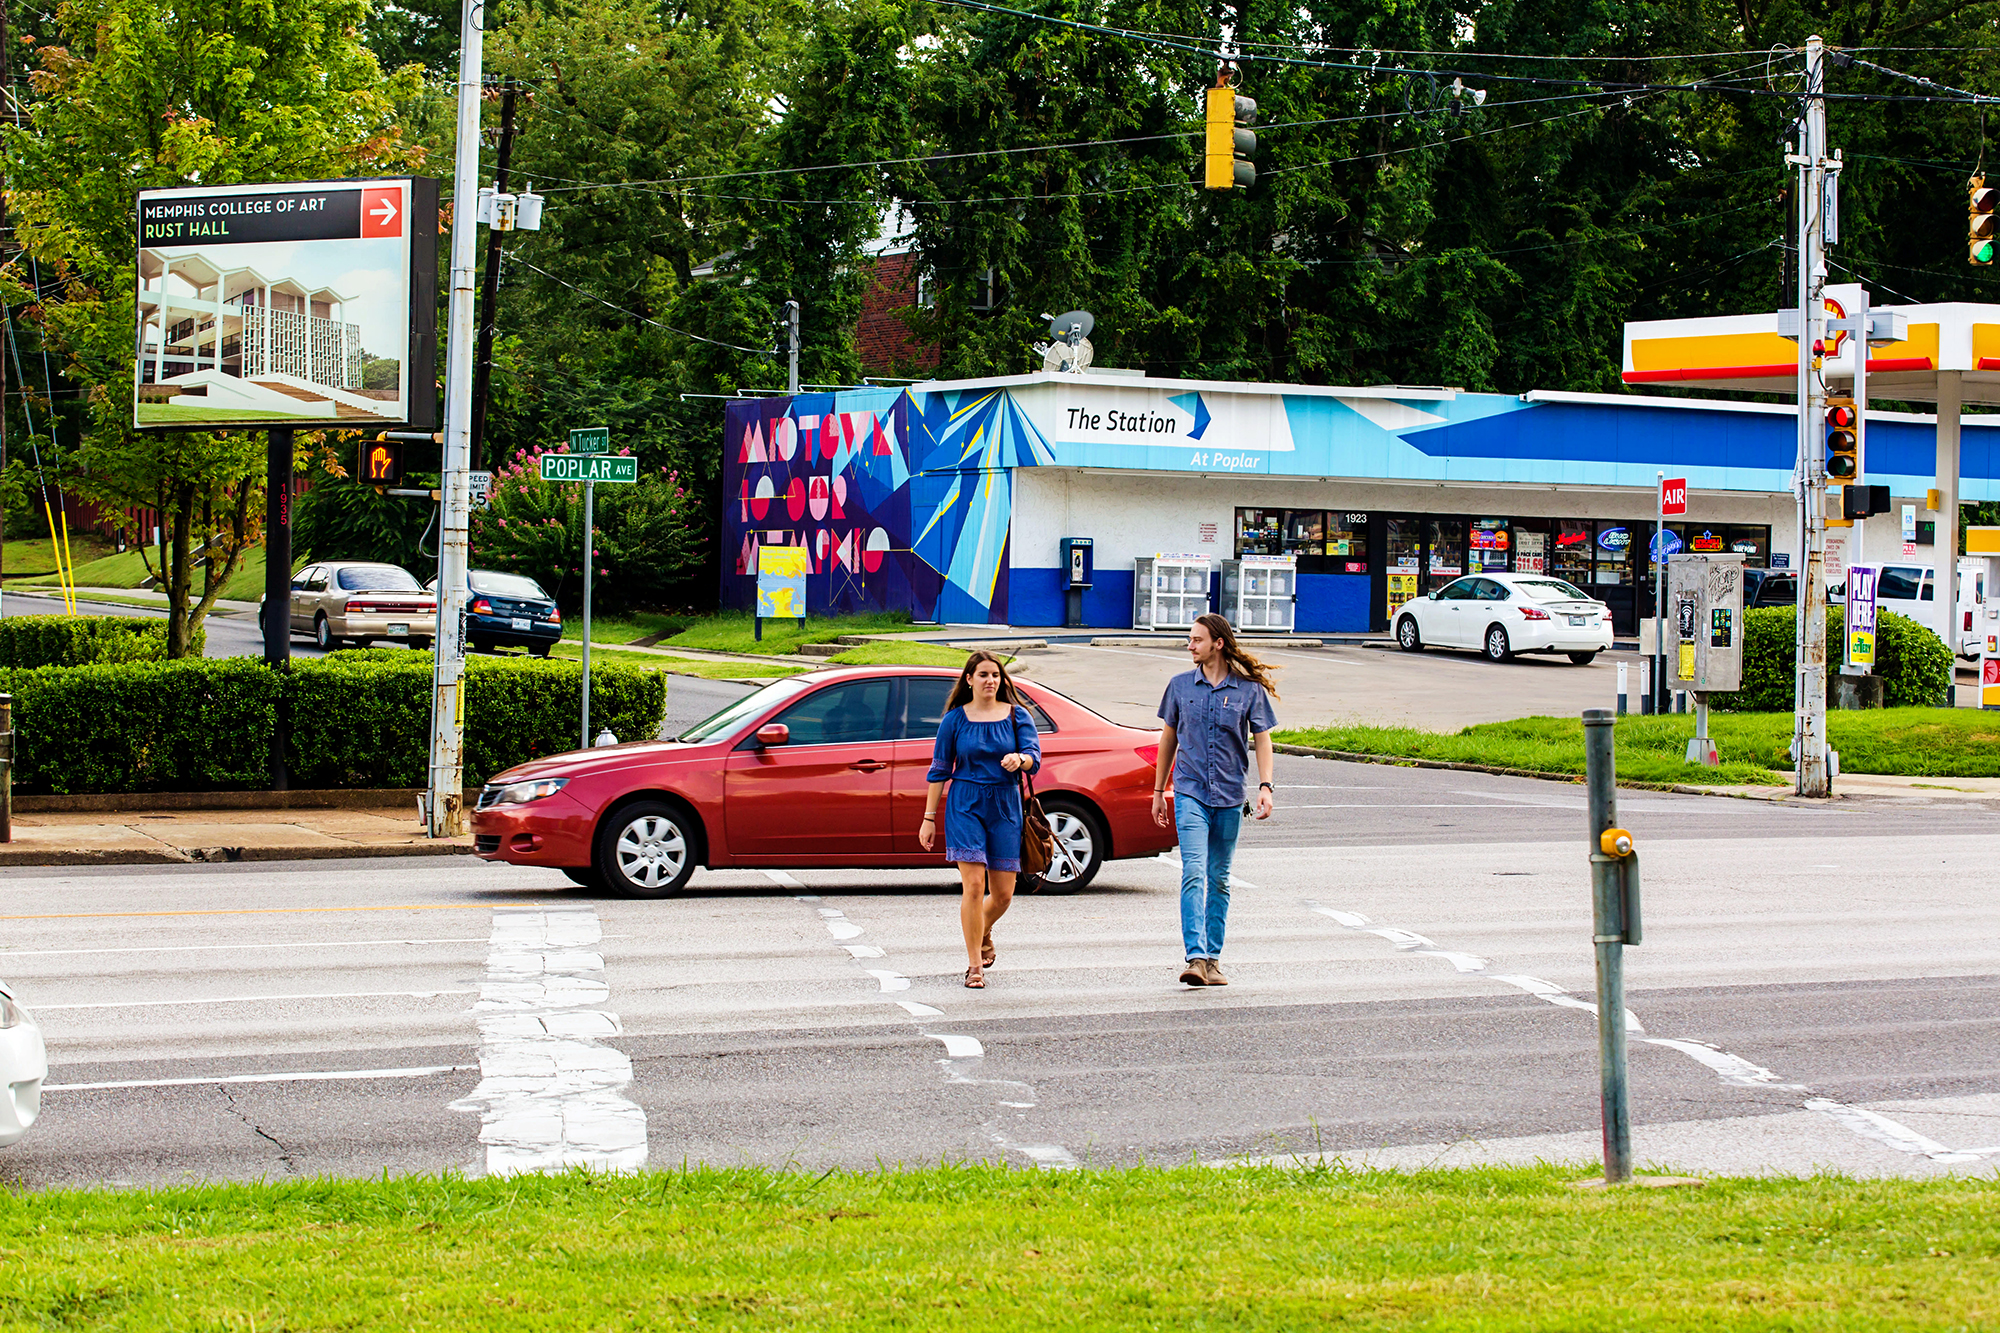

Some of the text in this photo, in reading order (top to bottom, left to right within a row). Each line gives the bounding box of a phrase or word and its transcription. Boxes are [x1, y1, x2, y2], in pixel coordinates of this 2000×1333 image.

[145, 198, 327, 219] MEMPHIS COLLEGE OF ART
[145, 220, 230, 239] RUST HALL
[1067, 408, 1176, 434] The Station
[571, 435, 577, 451] N
[578, 433, 600, 451] Tucker
[545, 458, 632, 479] POPLAR AVE
[1190, 452, 1260, 472] At Poplar
[786, 475, 847, 522] OUR
[1664, 488, 1684, 504] AIR
[1346, 513, 1367, 524] 1923
[1924, 524, 1934, 532] AT
[1517, 557, 1543, 570] $11.69
[1852, 572, 1874, 600] PLAY
[1852, 600, 1873, 627] HERE
